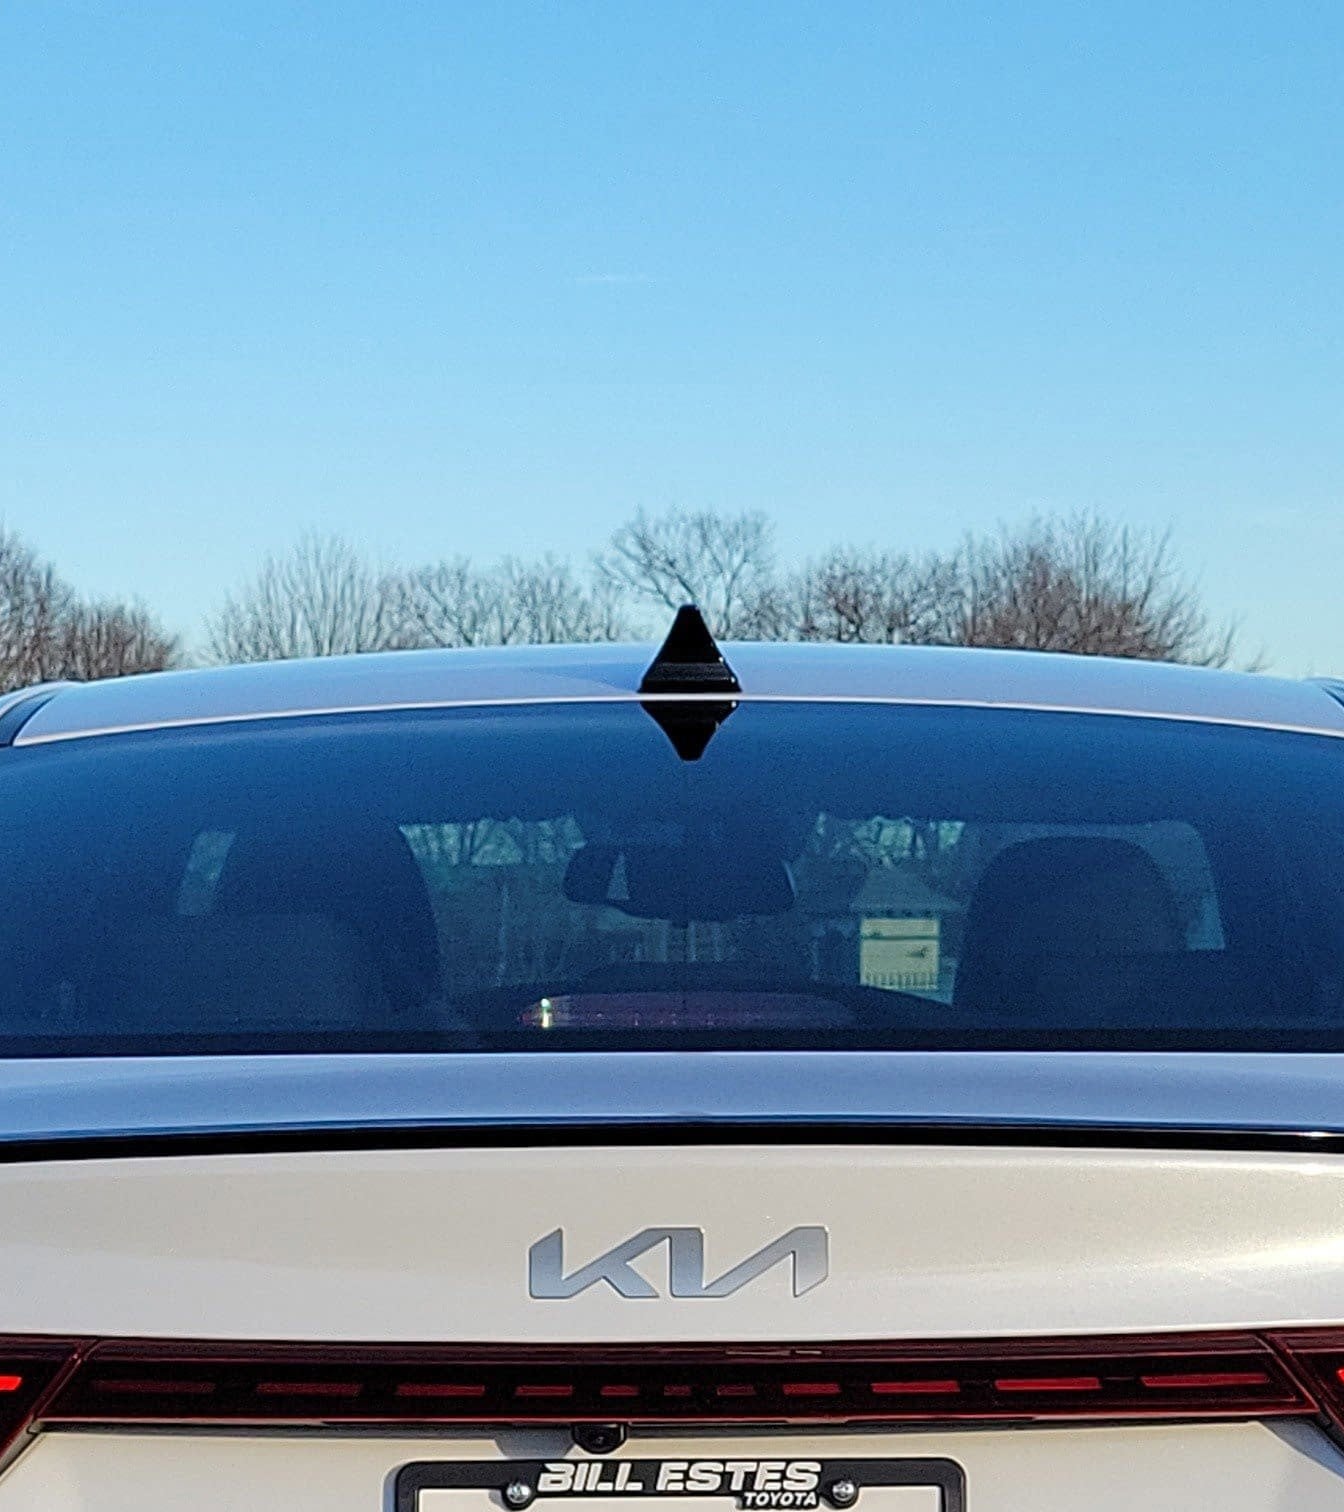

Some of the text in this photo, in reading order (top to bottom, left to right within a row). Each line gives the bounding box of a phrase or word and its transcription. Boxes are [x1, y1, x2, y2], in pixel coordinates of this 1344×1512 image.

[537, 1461, 821, 1491] BILL ESTES
[744, 1491, 818, 1507] TOYOTA
